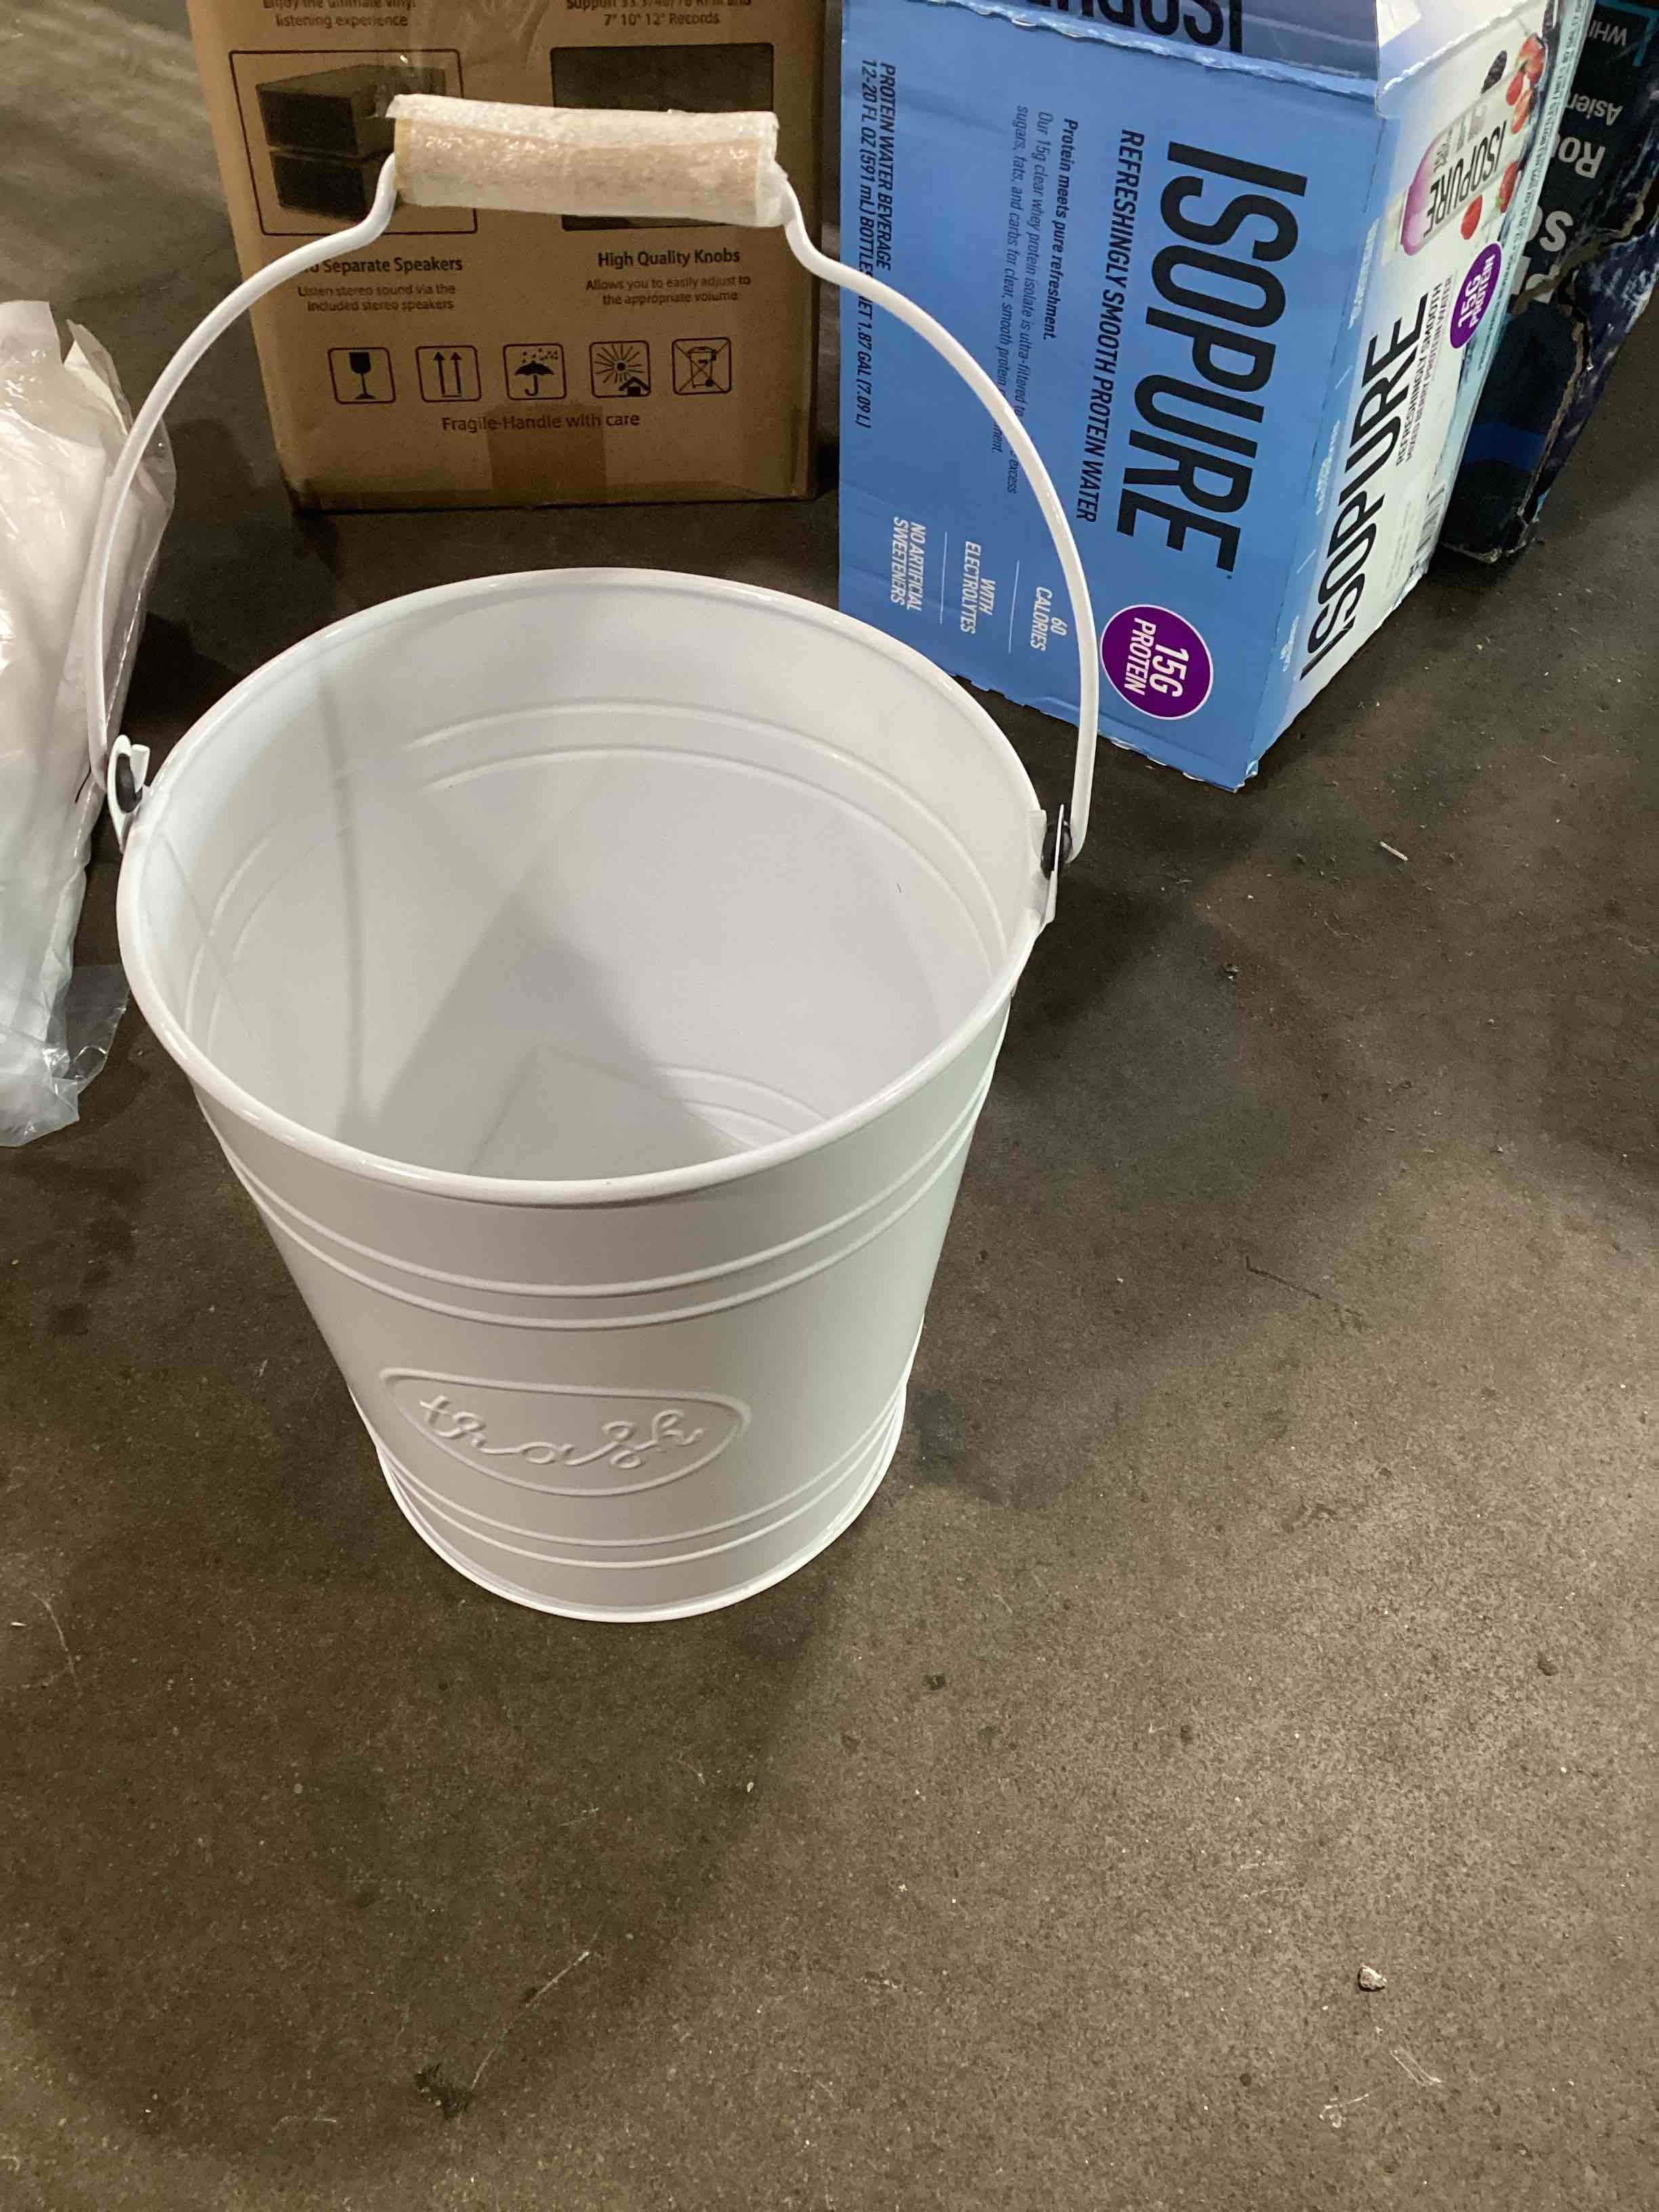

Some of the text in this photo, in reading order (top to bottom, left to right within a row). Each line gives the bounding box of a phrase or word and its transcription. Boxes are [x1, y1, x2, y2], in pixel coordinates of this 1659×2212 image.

[275, 14, 409, 28] listening experience
[668, 12, 720, 25] Records
[861, 59, 878, 102] 12-20
[861, 104, 876, 122] FL
[1012, 105, 1029, 150] sugars,
[1037, 111, 1054, 136] Our
[861, 126, 876, 147] OZ
[1031, 139, 1050, 162] 15g
[859, 148, 876, 182] (591
[876, 62, 896, 270] PROTEIN WATER BEVERAGE
[1011, 155, 1028, 182] fats,
[1033, 163, 1048, 197] clear
[1424, 119, 1507, 237] ISOPURE
[858, 184, 876, 216] mL)
[1010, 186, 1023, 211] and
[1027, 198, 1045, 233] whey
[1007, 213, 1022, 246] carbs
[1043, 118, 1078, 340] Protein meets pure refreshment.
[323, 259, 390, 276] Separate
[394, 256, 463, 274] Speakers
[598, 247, 740, 270] High Quality Knobs
[1005, 247, 1021, 266] for
[1025, 230, 1040, 276] protein
[298, 283, 456, 297] Listen stereo sound via the
[586, 275, 751, 291] Allows you to easily adjust to
[602, 291, 738, 306] the appropriate volume
[1002, 268, 1018, 299] clear,
[1021, 278, 1037, 317] isolate
[1469, 255, 1496, 329] PROTEIN
[308, 299, 454, 312] included stereo speakers
[1458, 274, 1482, 328] 15G
[999, 301, 1014, 348] smooth
[1020, 319, 1034, 331] is
[1076, 129, 1145, 523] REFRESHINGLY SMOOTH PROTEIN WATER
[1422, 283, 1443, 354] SMOOTH
[857, 321, 872, 351] 1.87
[857, 351, 872, 375] GAL
[996, 346, 1010, 386] protein
[1015, 332, 1033, 403] ultra-filtered
[1117, 140, 1308, 573] ISOPURE
[856, 379, 872, 413] (7.09
[441, 413, 640, 433] Fragile-Handle with care
[1007, 457, 1019, 494] excess
[1300, 292, 1429, 680] ISOPURE
[890, 516, 909, 606] SWEETENERS
[907, 522, 926, 611] NO ARTIFICIAL
[960, 541, 982, 634] ELECTROLYTES
[979, 577, 996, 616] WITH
[1030, 586, 1052, 651] CALORIES
[1050, 616, 1067, 636] 60
[1124, 617, 1156, 695] PROTEIN
[1149, 644, 1189, 697] 15G
